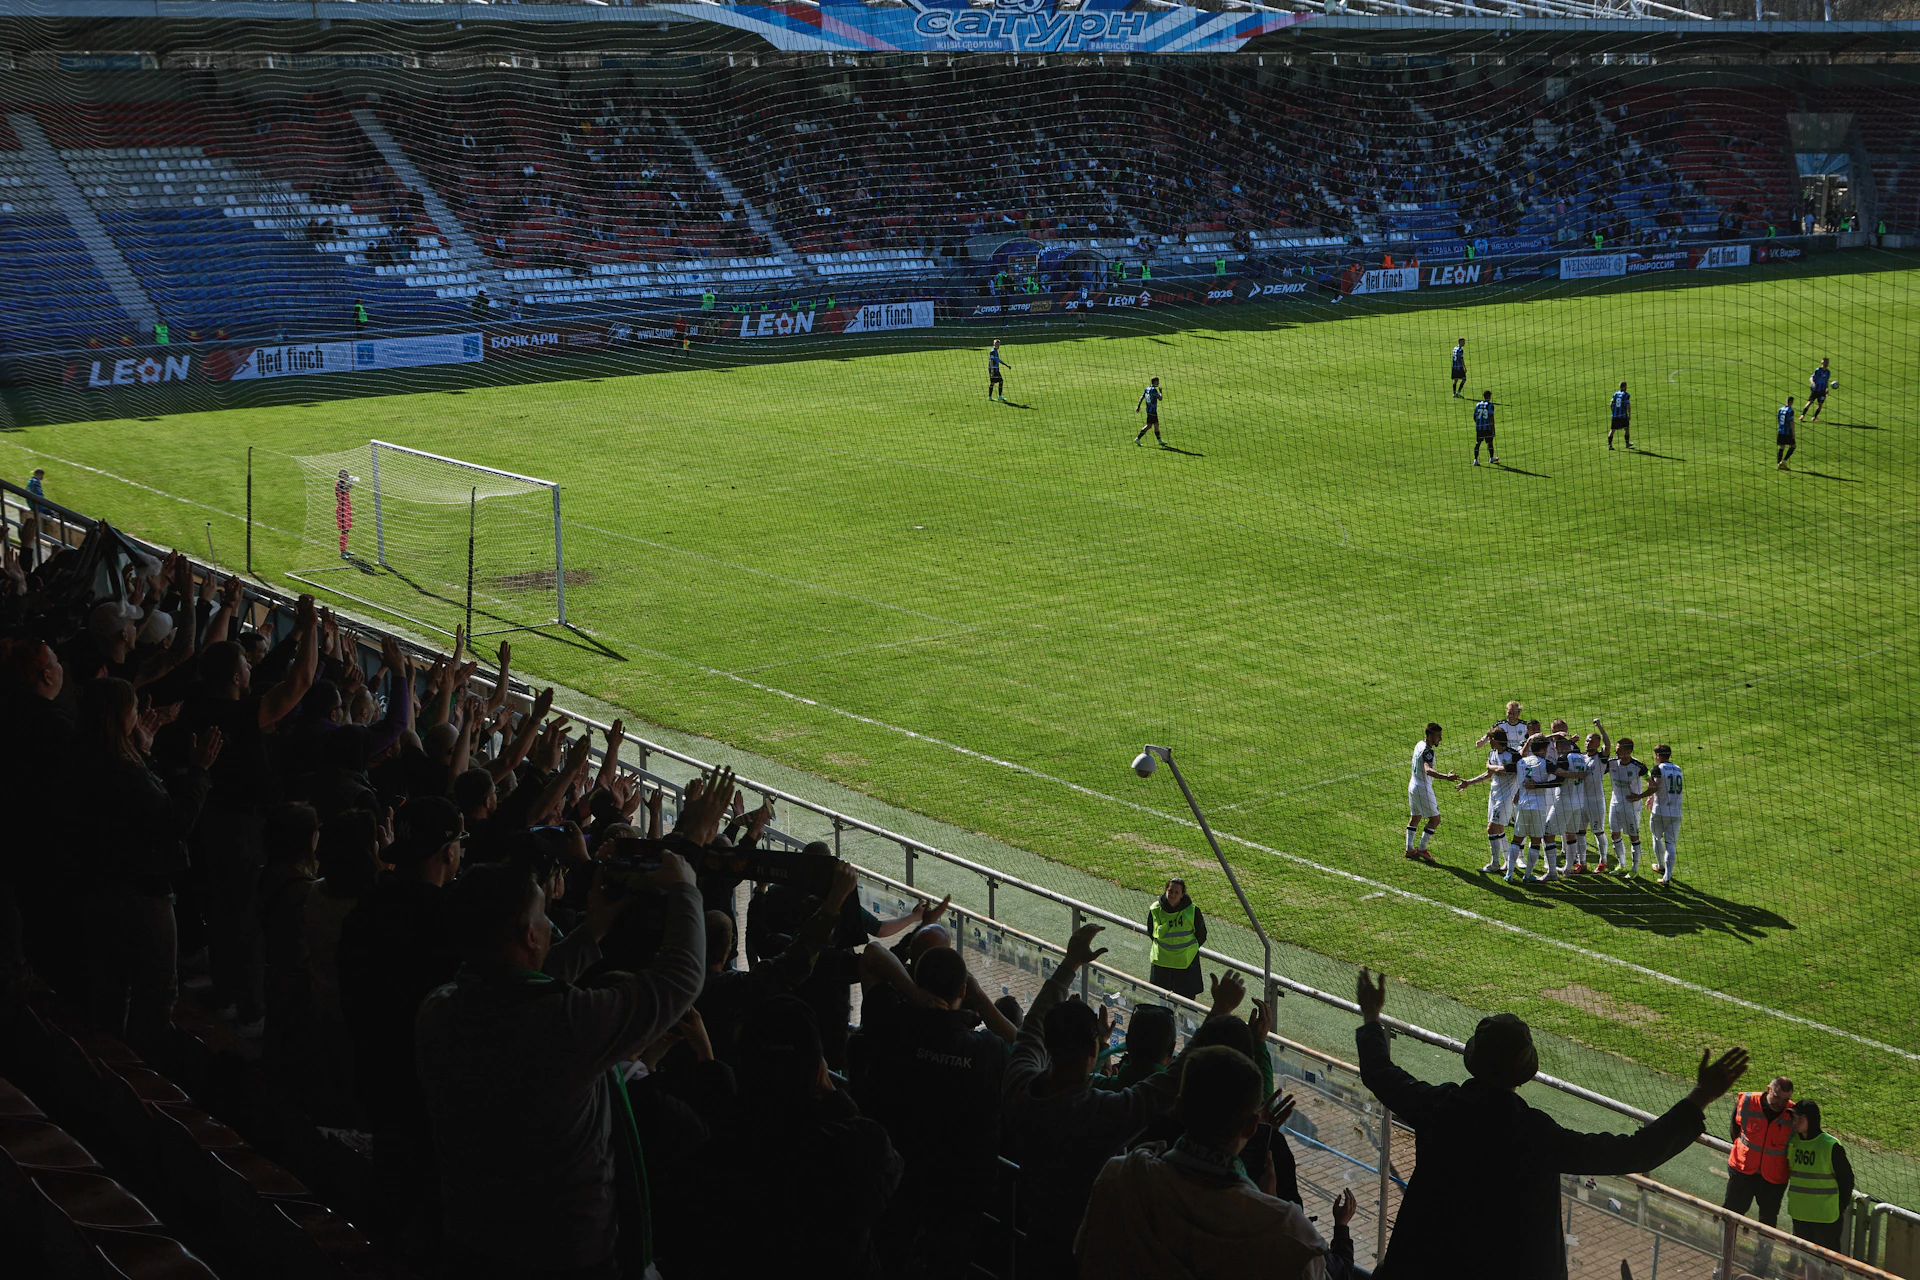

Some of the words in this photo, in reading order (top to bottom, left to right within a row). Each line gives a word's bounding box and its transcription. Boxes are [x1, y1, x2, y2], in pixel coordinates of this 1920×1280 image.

[1091, 42, 1134, 50] РАМЕНСКОЕ
[1769, 250, 1779, 258] VK
[1780, 248, 1801, 258] Видео
[1565, 257, 1611, 272] WEISSBERG
[1628, 259, 1675, 272] #МЫРОССИЯ
[1366, 274, 1380, 290] Red
[1383, 271, 1403, 288] finch
[1430, 265, 1481, 287] LEON
[1207, 289, 1233, 299] 2026
[1263, 282, 1308, 295] DEMIX
[1065, 299, 1094, 310] 206
[863, 305, 882, 329] Red
[886, 303, 913, 326] finch
[740, 311, 816, 337] LEON
[491, 333, 558, 349] БОЧКАРИ
[257, 349, 281, 376] Red
[287, 345, 323, 371] finch
[1615, 397, 1622, 408] 8
[1668, 774, 1683, 795] 19
[1593, 820, 1599, 829] 2
[1629, 823, 1635, 832] 5
[916, 1047, 972, 1069] SPARTAK
[1795, 1149, 1816, 1166] 5060
